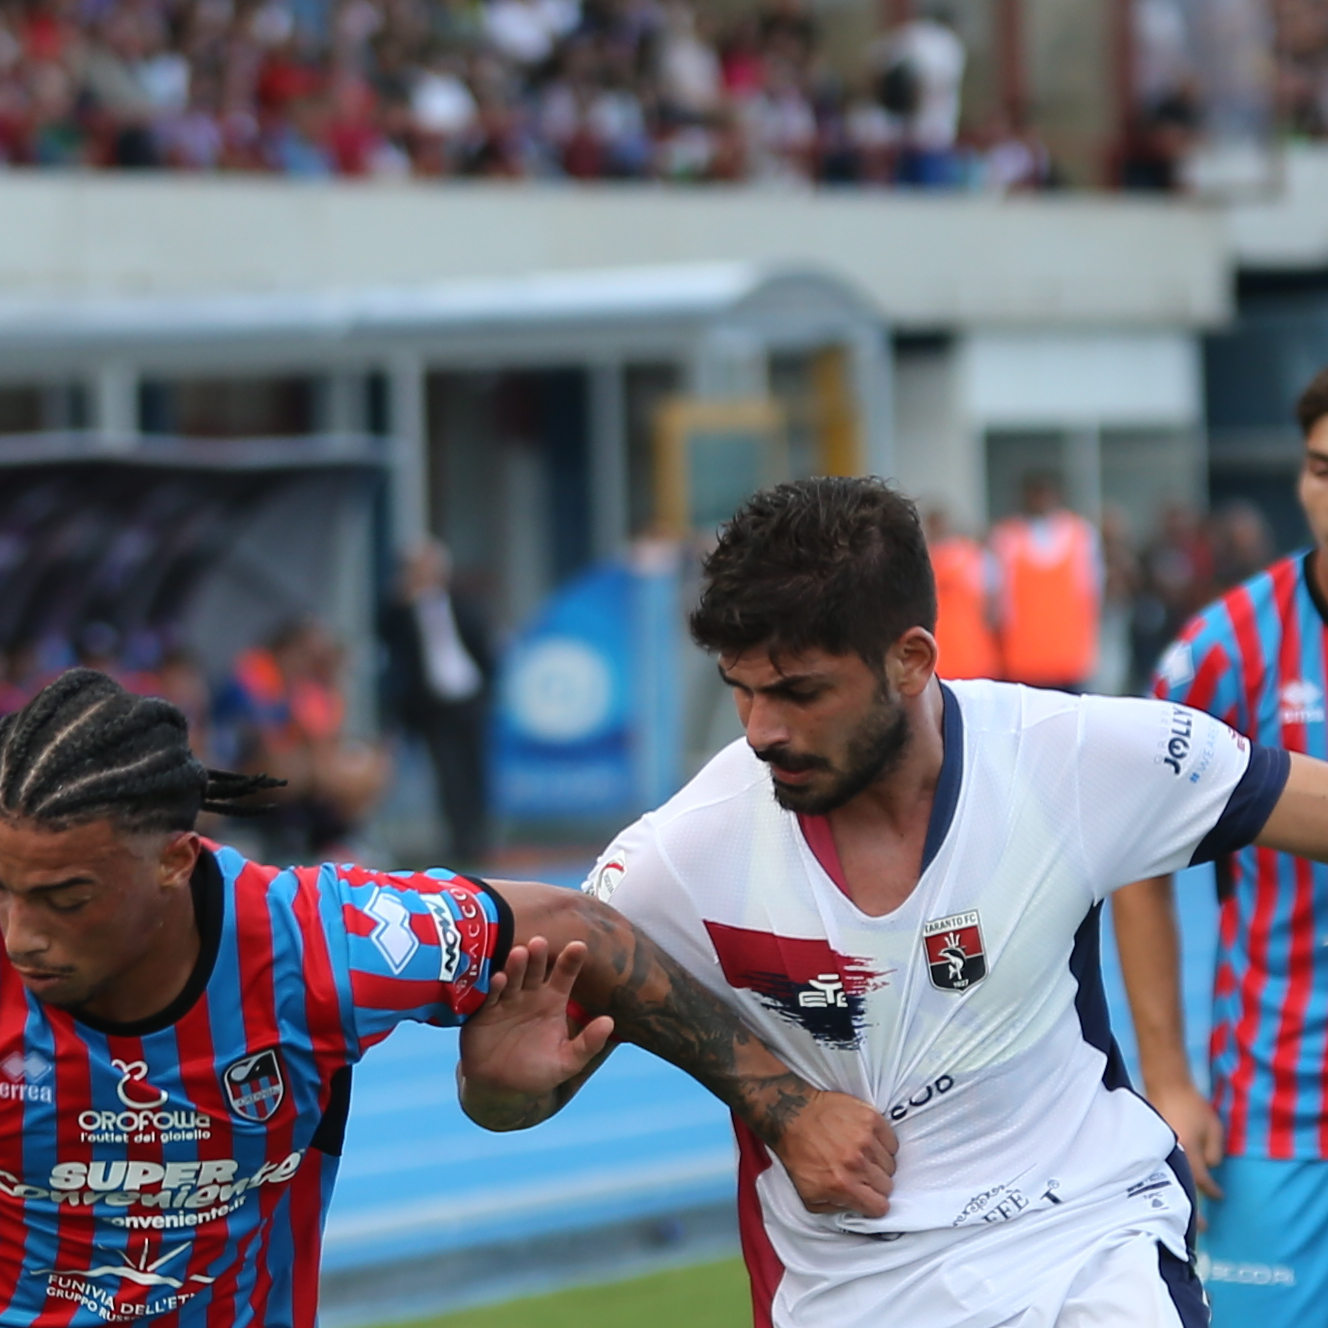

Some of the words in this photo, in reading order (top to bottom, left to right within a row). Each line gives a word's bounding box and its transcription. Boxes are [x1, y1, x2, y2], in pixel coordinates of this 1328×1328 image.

[1163, 706, 1193, 775] JOLLY
[924, 917, 963, 933] TARANTO
[964, 913, 977, 924] FC
[80, 1132, 129, 1143] l'outlet
[134, 1131, 155, 1143] del
[160, 1129, 211, 1144] gioiello
[49, 1158, 239, 1191] SUPER
[102, 1196, 248, 1230] onveniente.it
[46, 1286, 98, 1313] GRUPPO
[48, 1274, 115, 1311] FUNIVIA
[121, 1292, 196, 1316] DELL'ET
